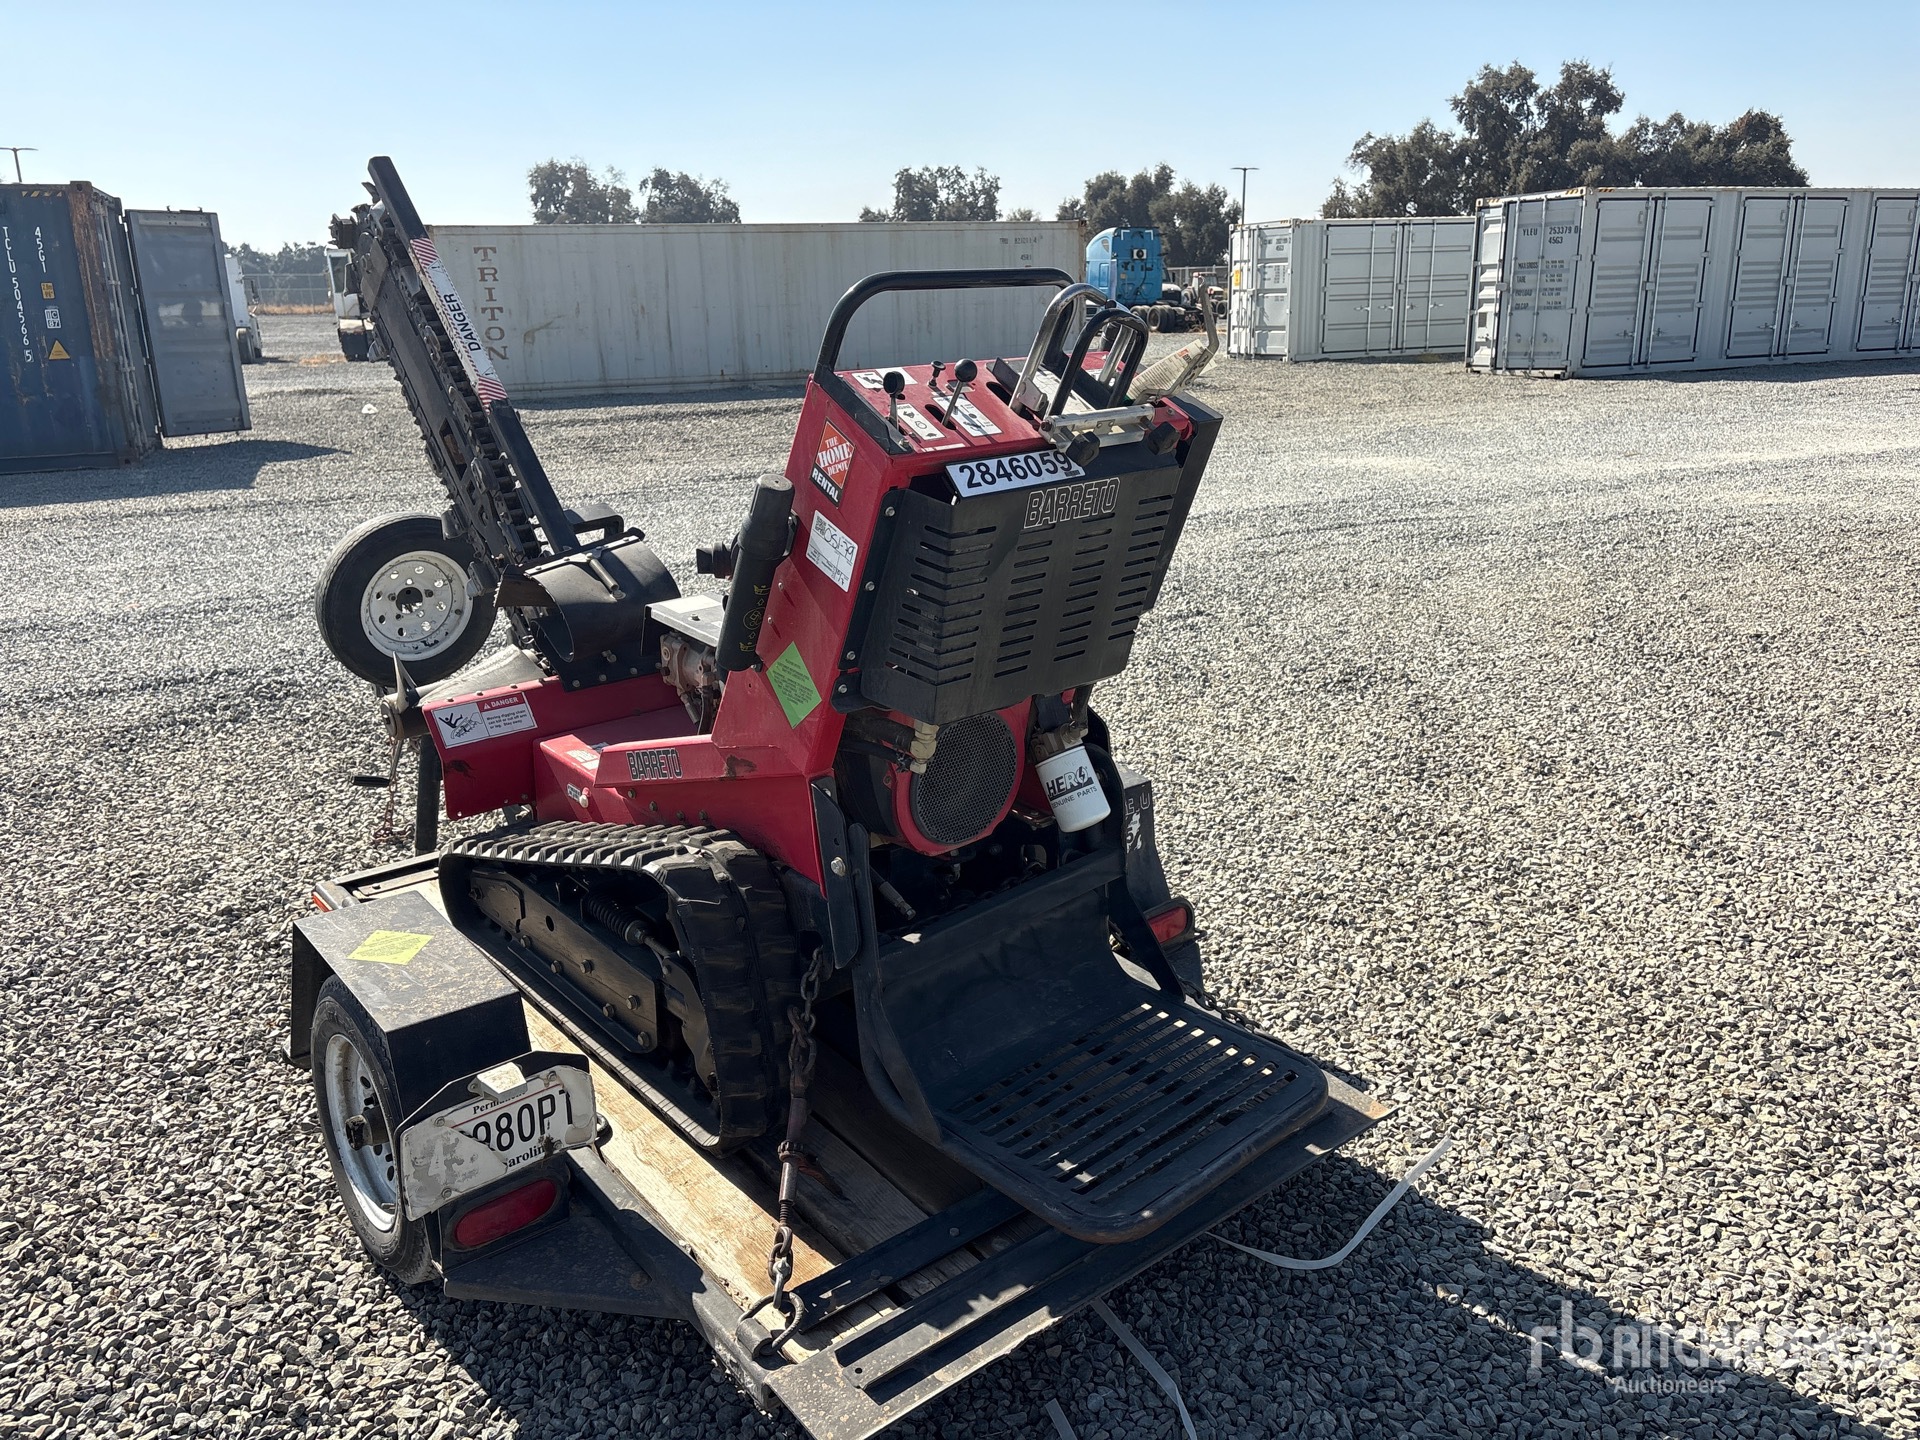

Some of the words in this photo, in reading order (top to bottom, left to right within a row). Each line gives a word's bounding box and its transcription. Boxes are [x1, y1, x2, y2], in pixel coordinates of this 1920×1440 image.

[1522, 228, 1538, 237] YLEU
[1548, 226, 1572, 235] 253379
[1548, 236, 1563, 244] 45G3
[35, 226, 47, 273] 45G1
[3, 226, 17, 273] TCLU
[12, 277, 29, 346] 504566
[25, 350, 32, 362] 5
[473, 246, 509, 361] TRITON
[443, 293, 481, 352] DANGER
[818, 442, 852, 468] HOME
[824, 435, 838, 448] THE
[827, 460, 848, 476] DEPOT
[959, 450, 1073, 489] 2846059
[811, 467, 839, 502] RENTAL
[1023, 476, 1121, 529] BARRETO
[491, 696, 519, 708] DANGER
[626, 747, 683, 781] BARRETO
[1046, 765, 1089, 797] HERO
[1077, 786, 1098, 799] PARTS
[503, 1144, 551, 1168] arolin
